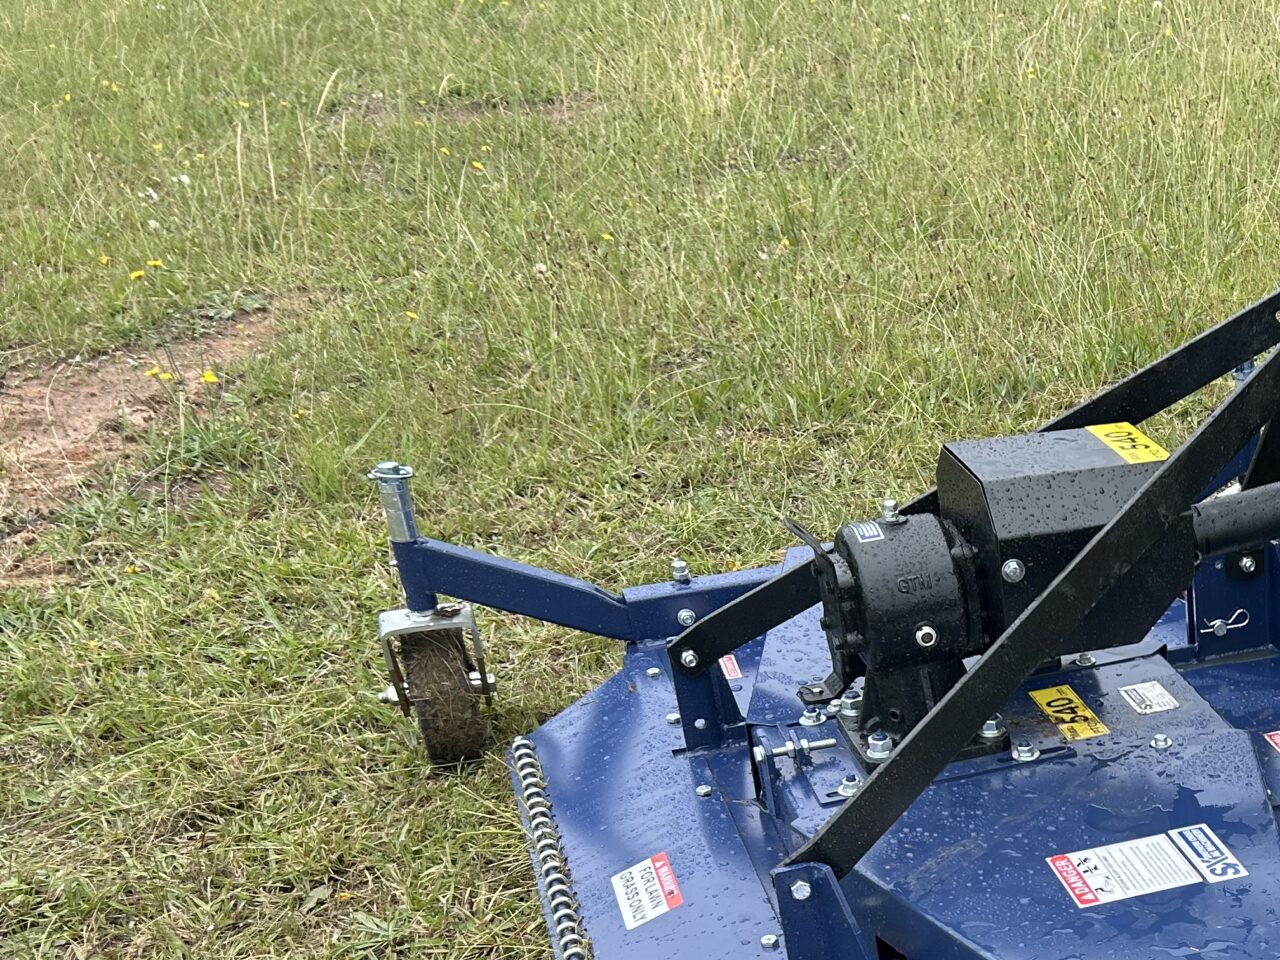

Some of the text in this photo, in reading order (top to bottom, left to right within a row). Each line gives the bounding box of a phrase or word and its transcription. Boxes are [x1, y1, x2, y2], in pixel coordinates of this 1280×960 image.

[1104, 431, 1151, 450] 540
[1046, 697, 1089, 724] 540
[638, 866, 663, 910] FOR LAWN
[1056, 859, 1088, 896] DANGER
[620, 871, 648, 922] GRASS ONLY
